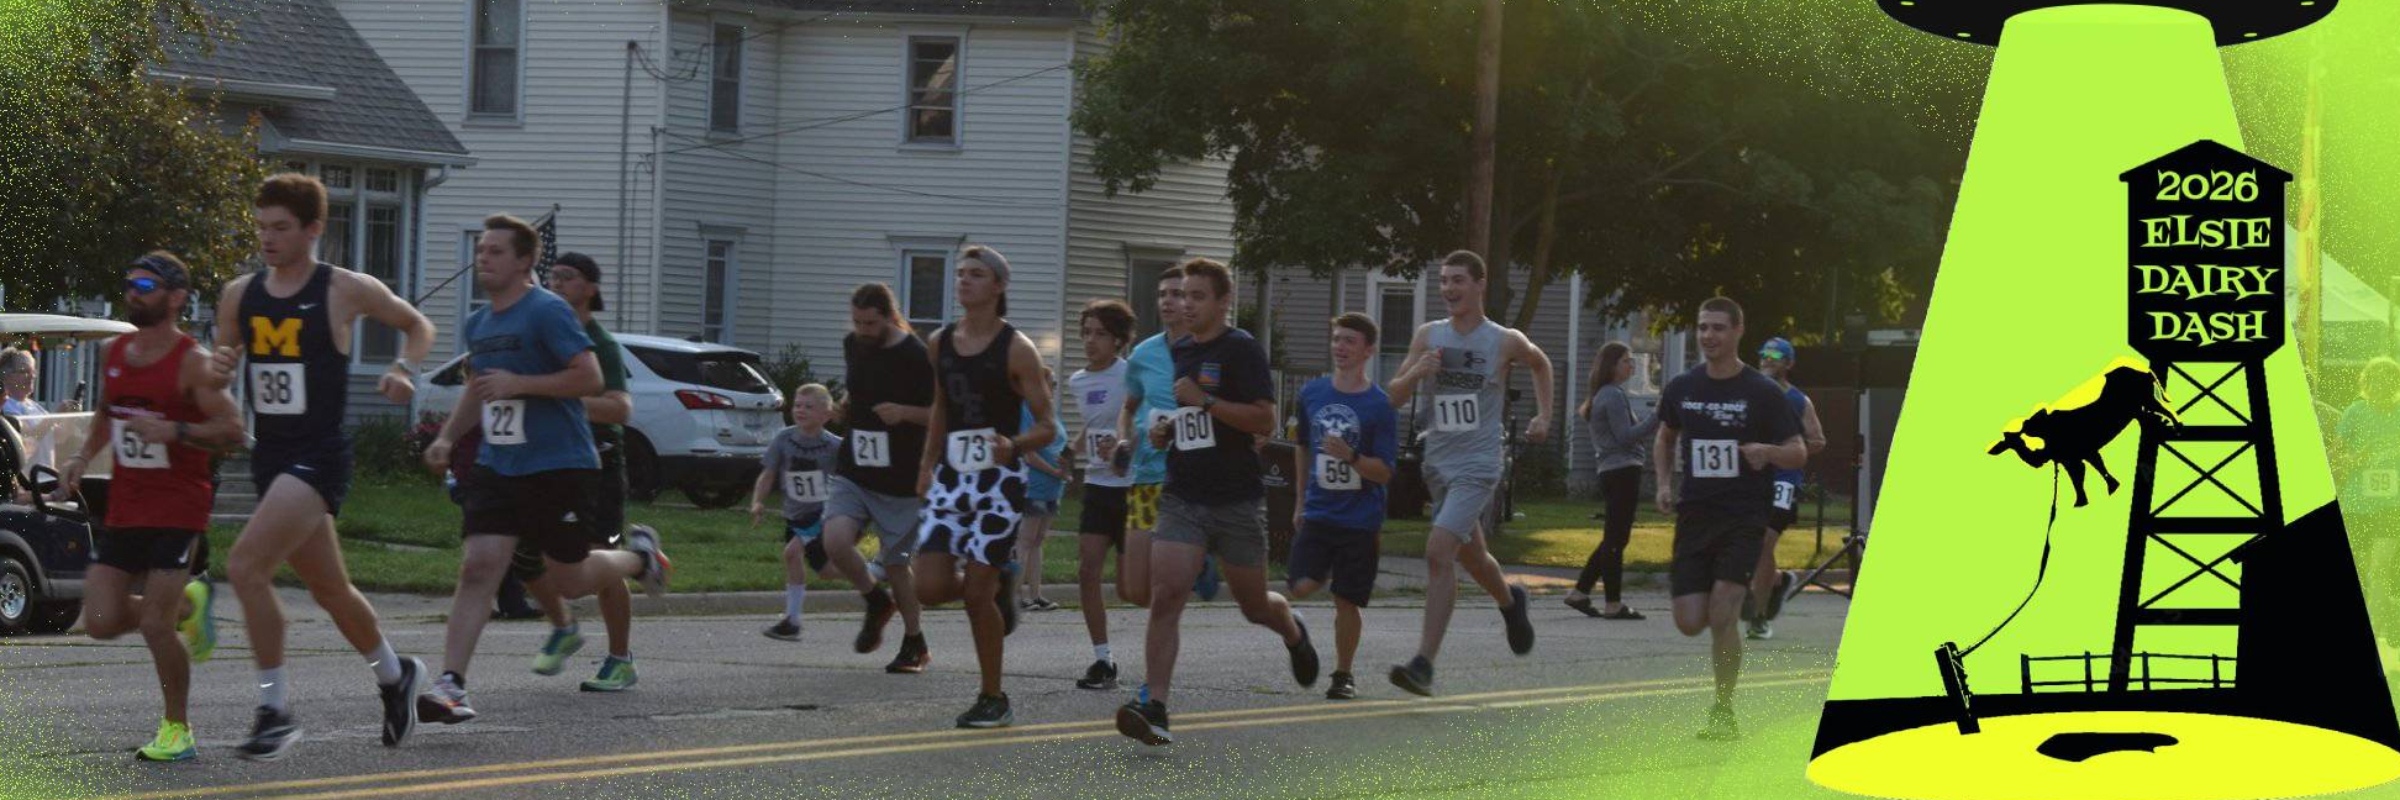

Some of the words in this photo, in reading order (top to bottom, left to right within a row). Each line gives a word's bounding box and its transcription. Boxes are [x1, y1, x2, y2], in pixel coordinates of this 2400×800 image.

[250, 316, 303, 357] M
[260, 370, 292, 404] 38
[491, 405, 514, 436] 22
[1438, 400, 1476, 424] 110
[1176, 411, 1209, 442] 160
[858, 436, 878, 459] 21
[957, 435, 986, 463] 73
[1698, 445, 1733, 470] 131
[1325, 459, 1351, 483] 59
[793, 476, 815, 496] 61
